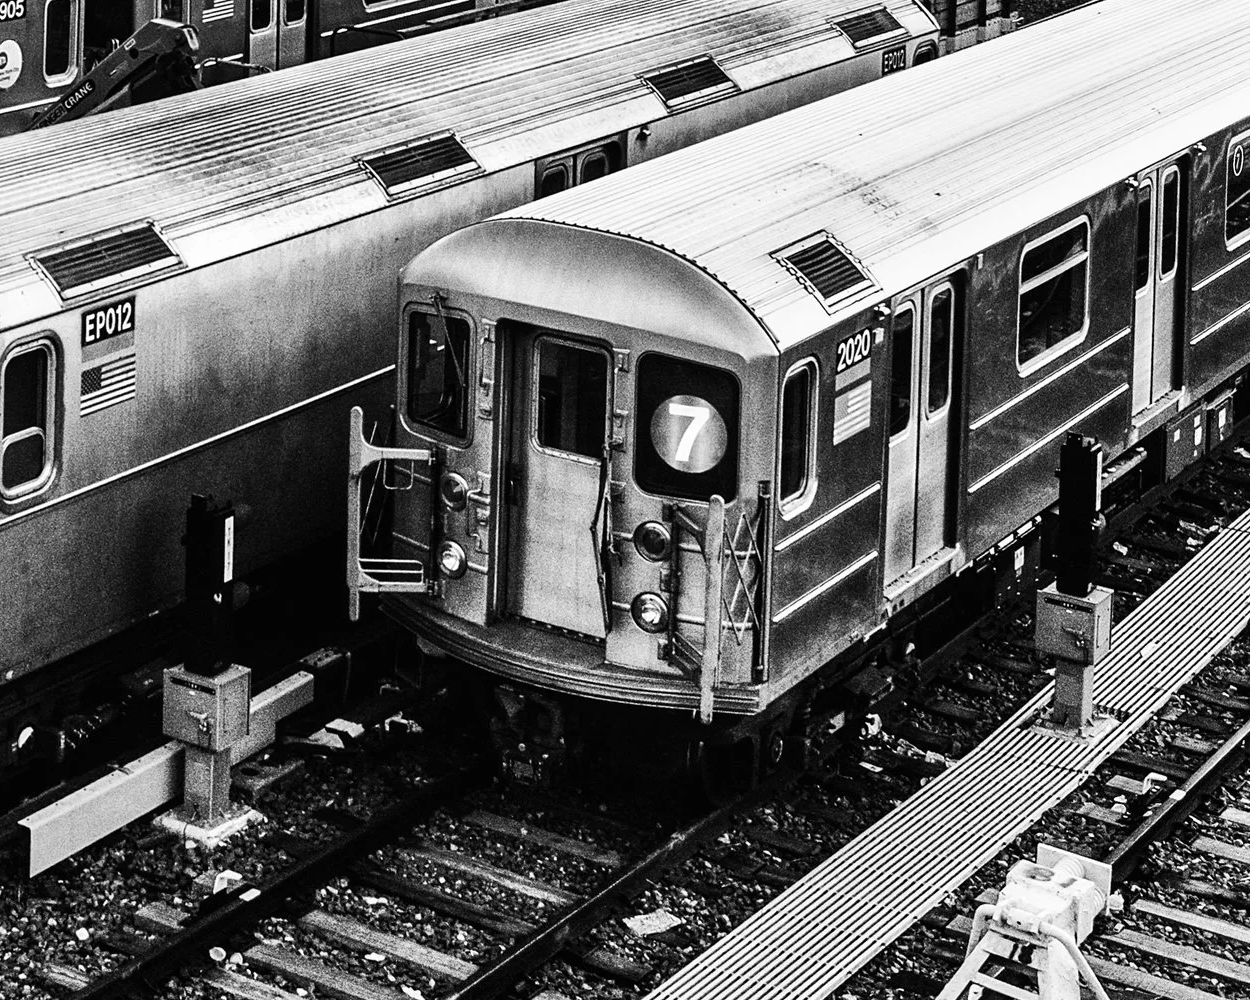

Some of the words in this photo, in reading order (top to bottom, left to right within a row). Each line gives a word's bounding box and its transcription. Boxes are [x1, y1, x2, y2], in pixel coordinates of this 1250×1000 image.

[884, 49, 904, 71] EP012
[64, 81, 93, 109] CRANE
[85, 301, 132, 342] EP012
[836, 328, 871, 372] 2020
[668, 402, 710, 462] 7
